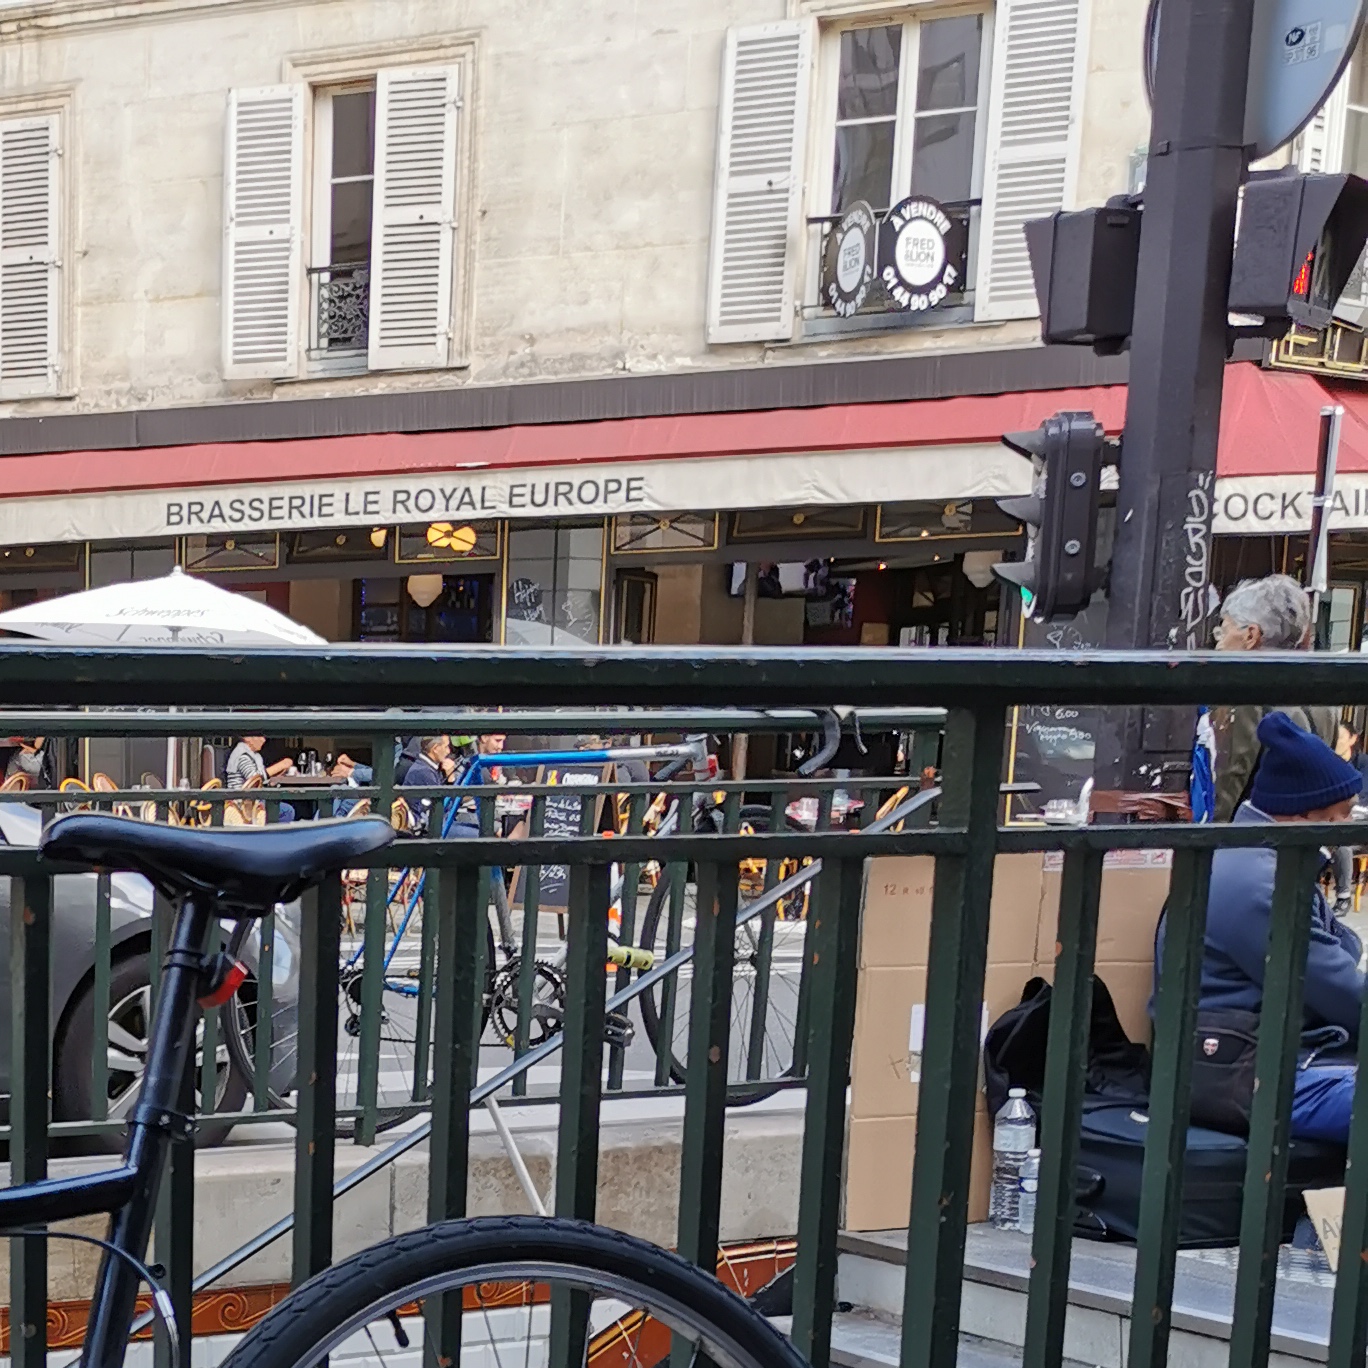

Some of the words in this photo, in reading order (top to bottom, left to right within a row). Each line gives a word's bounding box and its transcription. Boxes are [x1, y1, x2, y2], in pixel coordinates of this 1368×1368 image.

[900, 201, 952, 235] VENDRE
[905, 237, 935, 251] FRED
[892, 286, 910, 309] 44
[910, 293, 929, 311] 90
[928, 282, 948, 307] 90
[165, 493, 334, 526] BRASSERIE
[345, 490, 380, 515] LE
[392, 483, 497, 514] ROYAL
[508, 477, 646, 509] EUROPE
[1211, 486, 1368, 522] OCKAI
